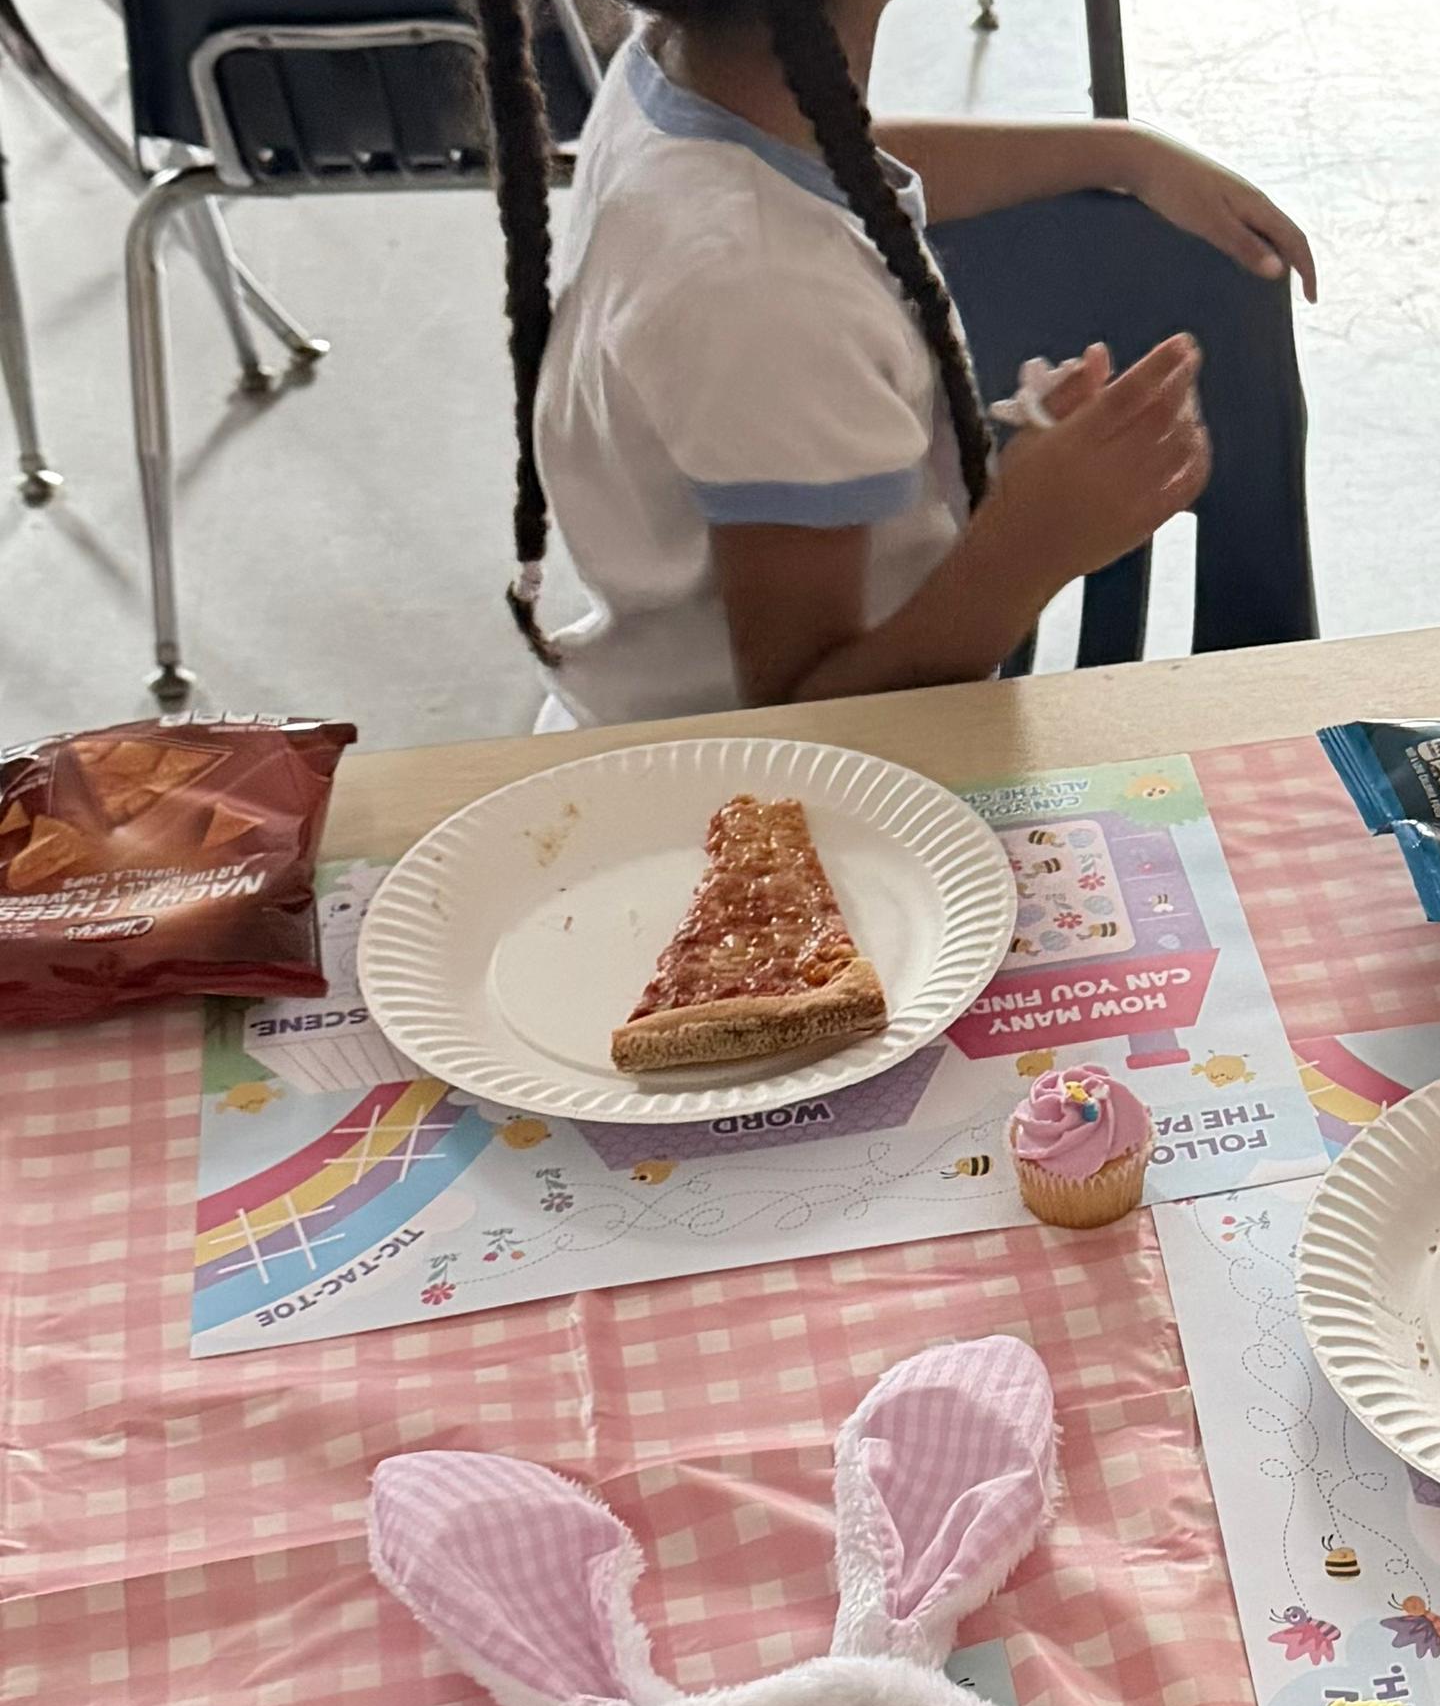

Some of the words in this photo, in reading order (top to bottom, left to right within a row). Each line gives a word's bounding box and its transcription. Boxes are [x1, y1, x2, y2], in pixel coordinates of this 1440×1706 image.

[1033, 795, 1080, 811] CAN
[62, 870, 109, 889] CHIPS
[113, 866, 183, 883] TORTILLA
[129, 870, 267, 911] NACHO
[0, 897, 122, 922] CHEES
[1051, 977, 1120, 1003] YOU
[1125, 967, 1192, 992] CAN
[962, 988, 1043, 1018] FIND
[1089, 992, 1168, 1020] HOW
[988, 1004, 1083, 1036] MANY
[712, 1101, 832, 1134] WORD
[1154, 1113, 1194, 1136] PA
[1200, 1102, 1276, 1130] THE
[1150, 1129, 1268, 1165] FOLLO
[255, 1226, 425, 1328] TIC-TAC-TOE
